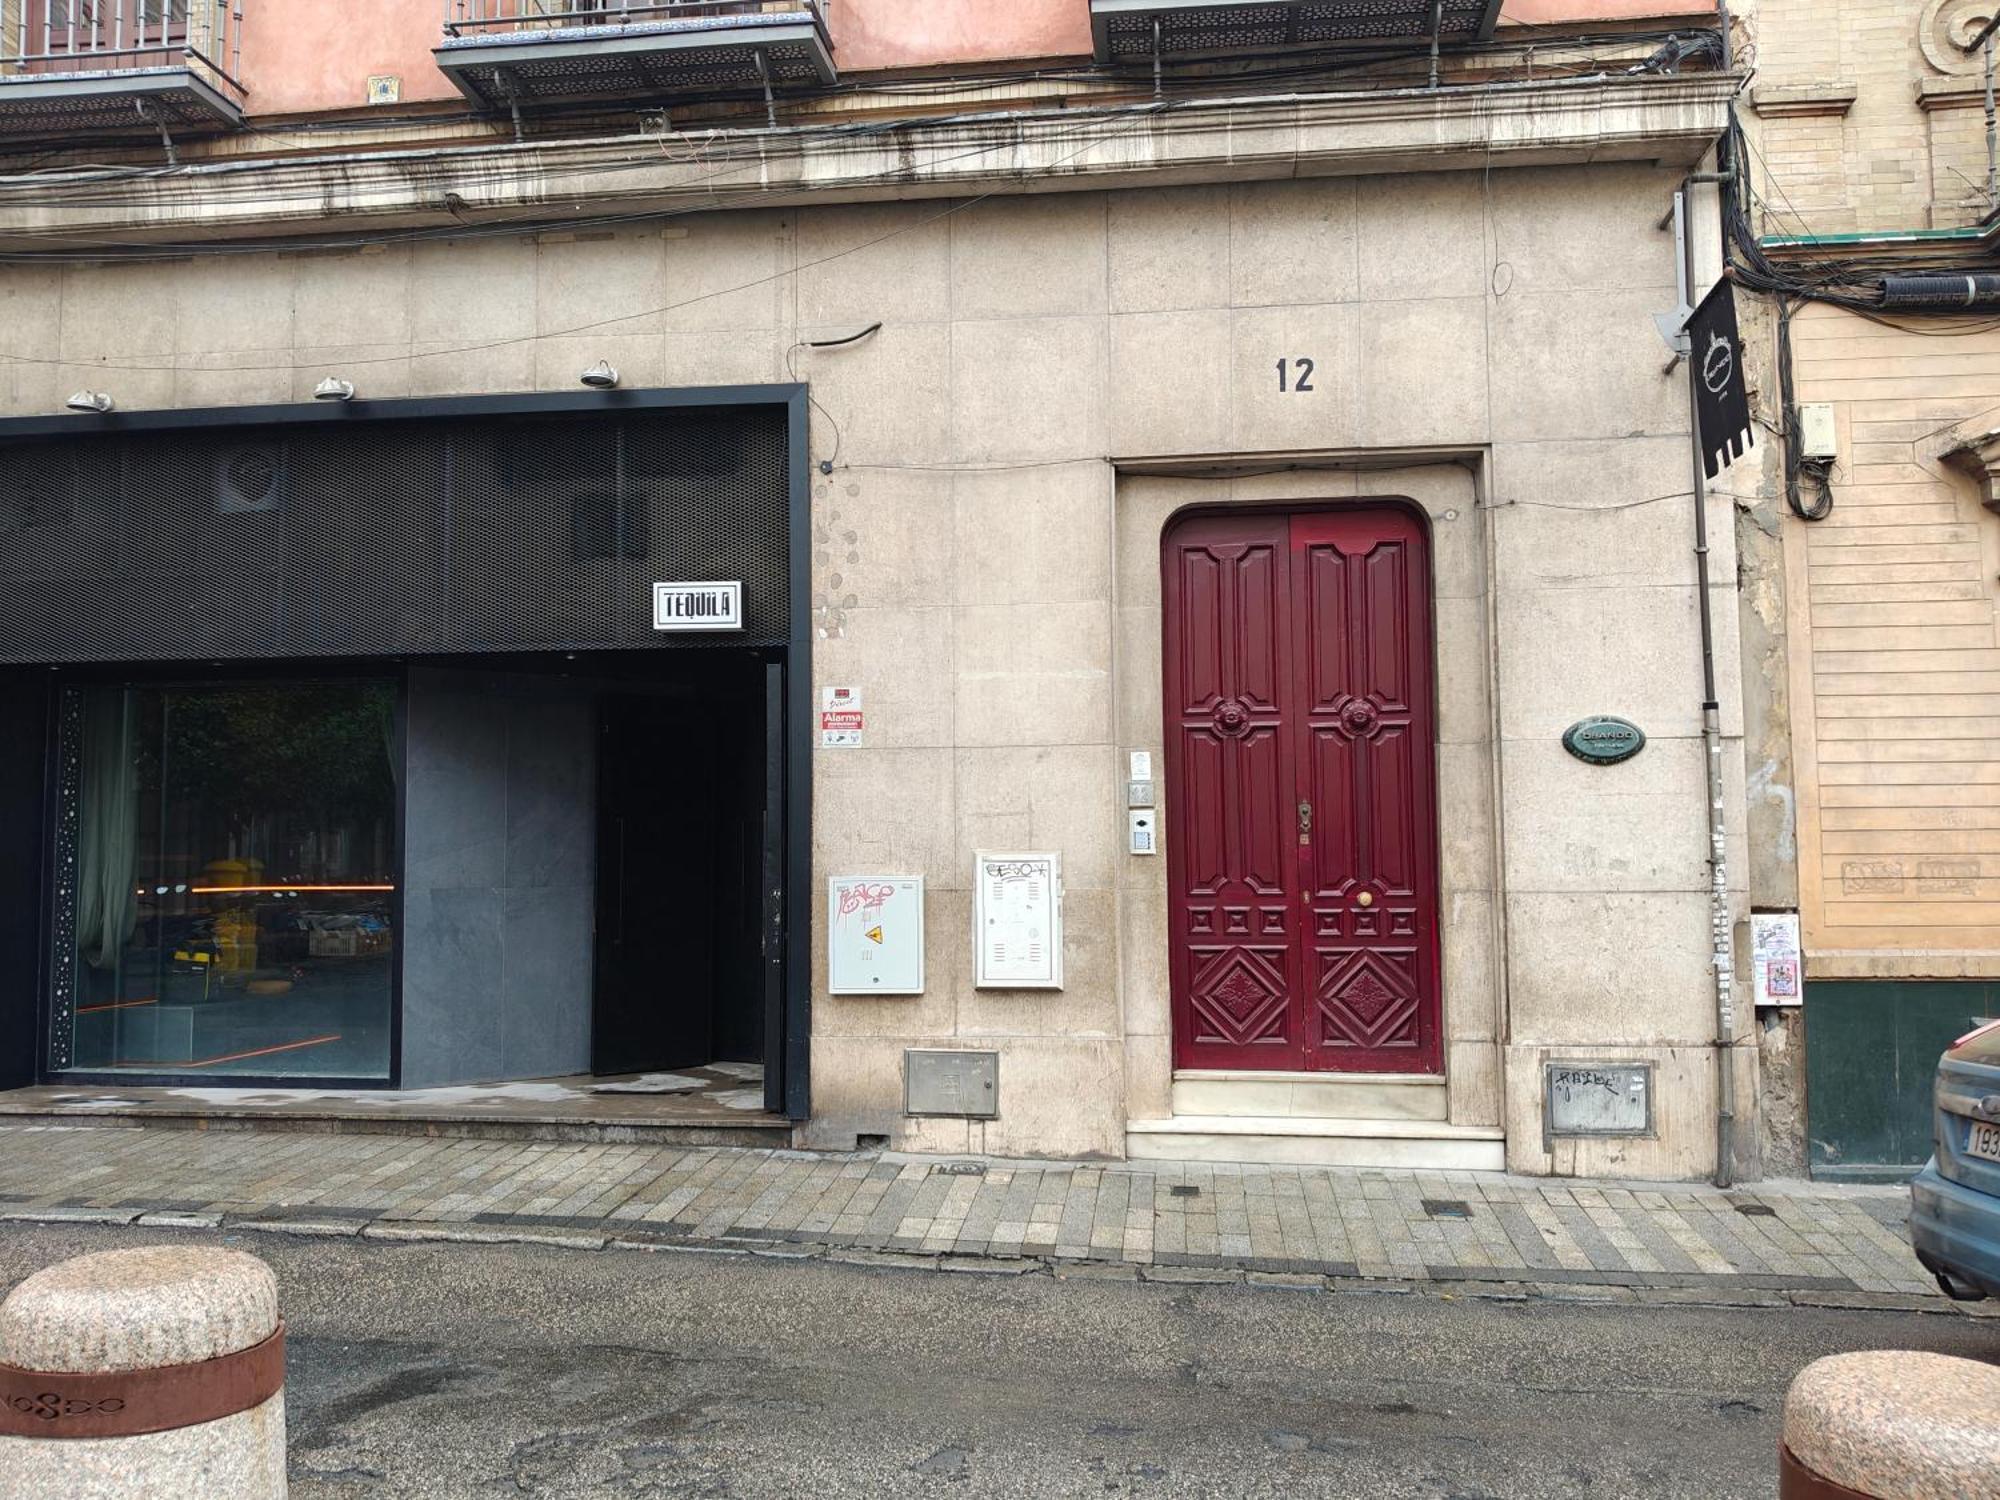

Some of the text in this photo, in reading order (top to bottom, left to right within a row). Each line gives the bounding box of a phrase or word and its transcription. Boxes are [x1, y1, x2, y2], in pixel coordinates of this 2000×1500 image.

[1276, 358, 1314, 392] 12
[663, 591, 730, 620] TEQUILA
[823, 711, 861, 722] Alarma
[1974, 1126, 2000, 1157] 193
